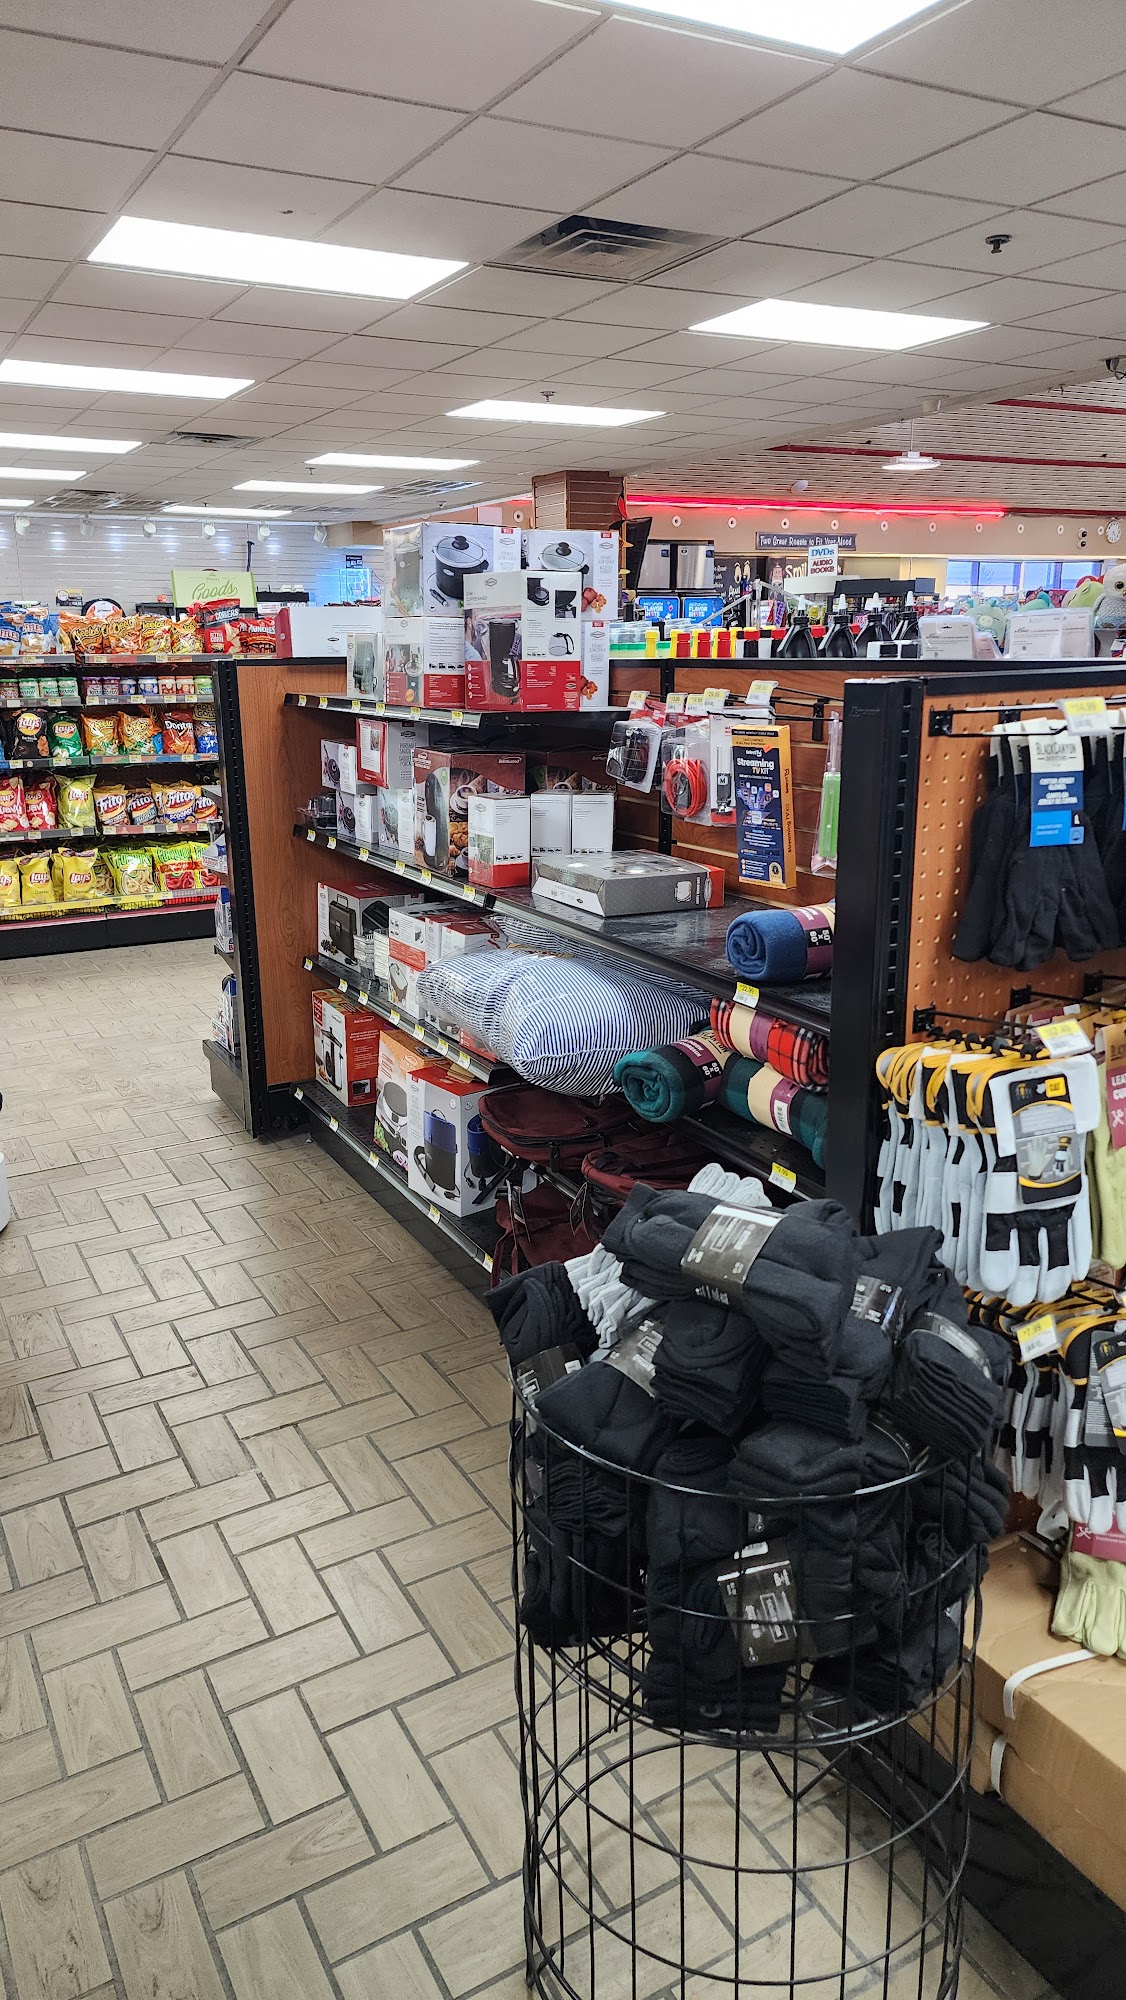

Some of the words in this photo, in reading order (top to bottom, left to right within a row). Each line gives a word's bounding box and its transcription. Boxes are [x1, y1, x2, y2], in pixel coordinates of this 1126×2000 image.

[760, 536, 771, 547] Two
[773, 536, 788, 547] Great
[809, 538, 814, 546] to
[838, 537, 852, 546] Mood
[811, 547, 835, 557] DVDs
[812, 558, 833, 567] AUDIO
[785, 562, 807, 578] Smil
[810, 566, 835, 575] BOOKS
[192, 580, 238, 600] Goods
[19, 717, 41, 730] Lay's
[737, 758, 775, 770] Streaming
[0, 792, 14, 802] ay's
[70, 873, 91, 884] Lay's
